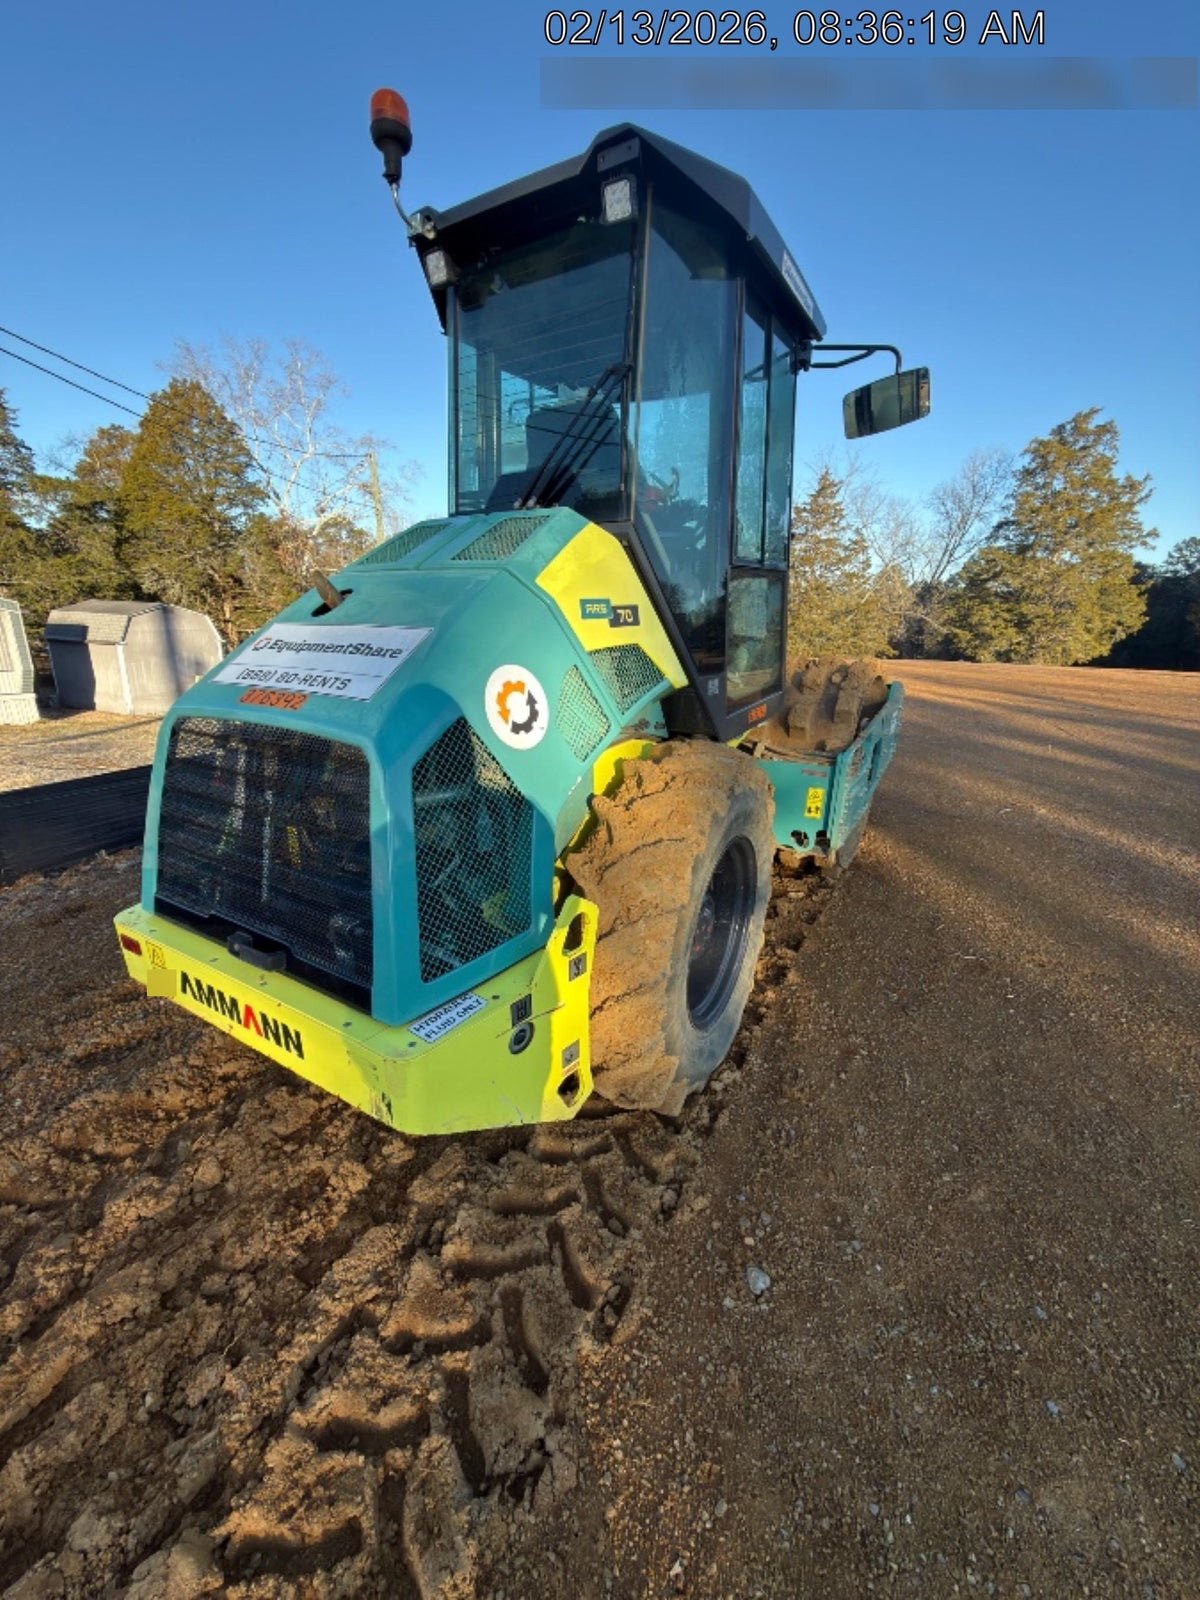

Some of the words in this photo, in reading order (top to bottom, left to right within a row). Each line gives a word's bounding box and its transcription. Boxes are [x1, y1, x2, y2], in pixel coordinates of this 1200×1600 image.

[616, 609, 634, 623] 70
[269, 639, 404, 659] EquipmentShare
[180, 971, 304, 1060] AMMANN
[424, 1016, 456, 1039] FLUID
[456, 998, 483, 1018] ONLY
